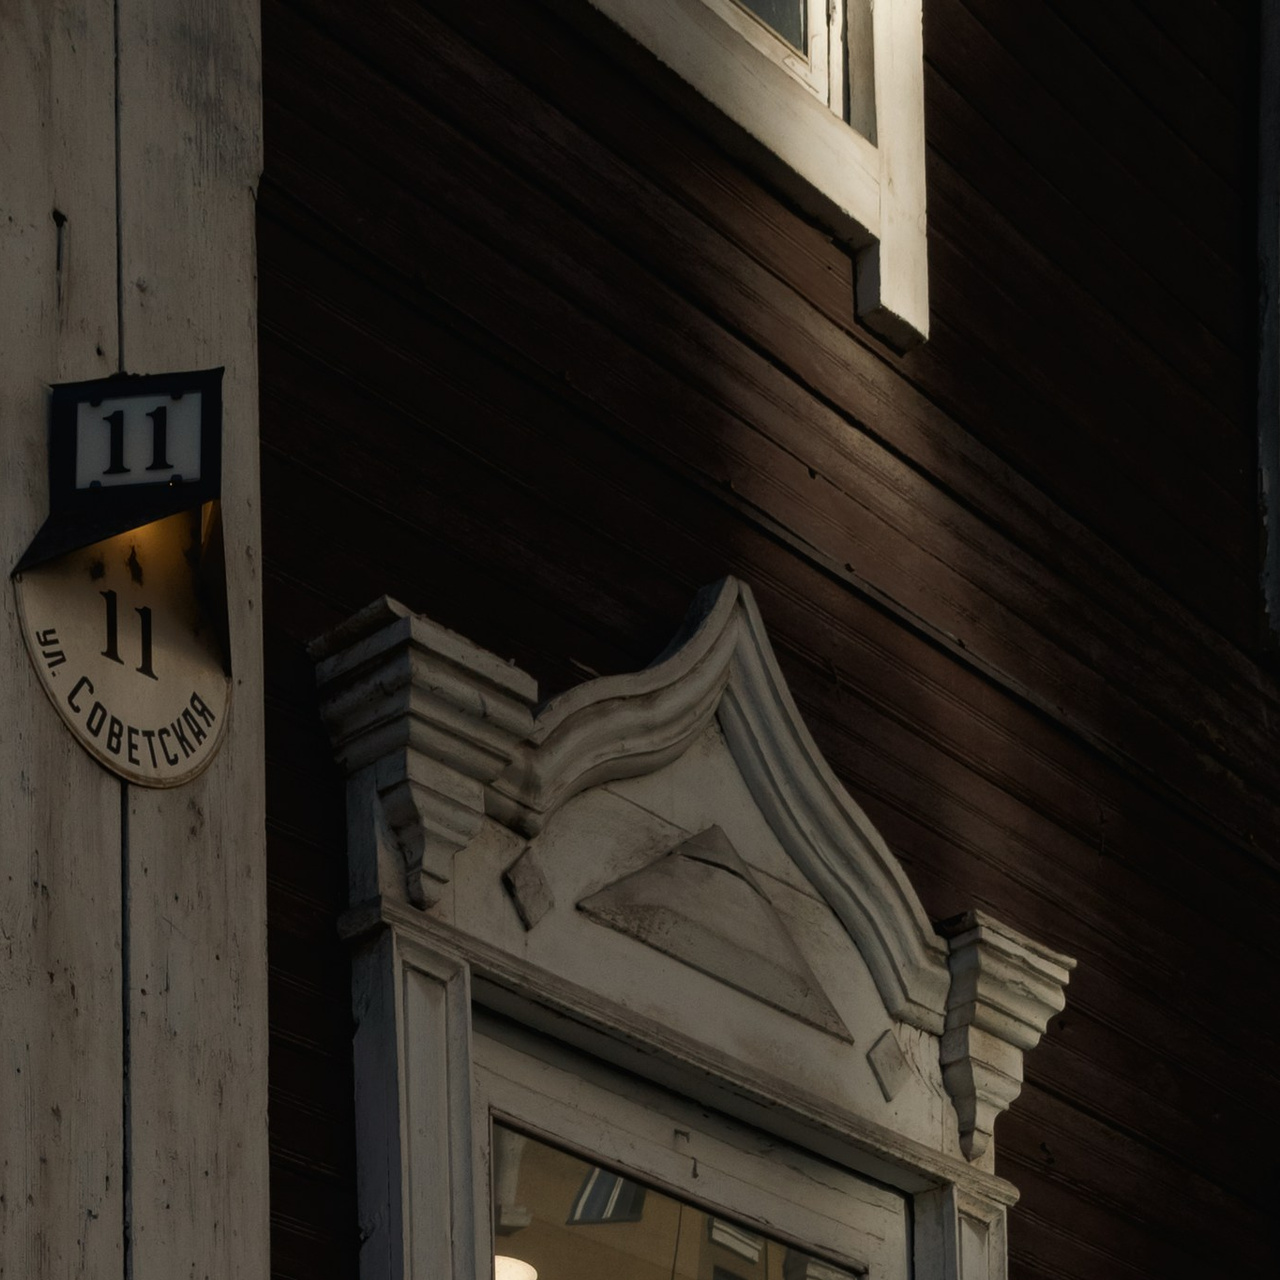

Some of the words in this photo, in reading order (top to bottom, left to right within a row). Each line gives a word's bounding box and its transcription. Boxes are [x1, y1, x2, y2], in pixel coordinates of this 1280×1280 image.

[102, 406, 174, 475] 11
[99, 589, 159, 681] 11
[67, 675, 216, 769] СОВЕТСКАЯ
